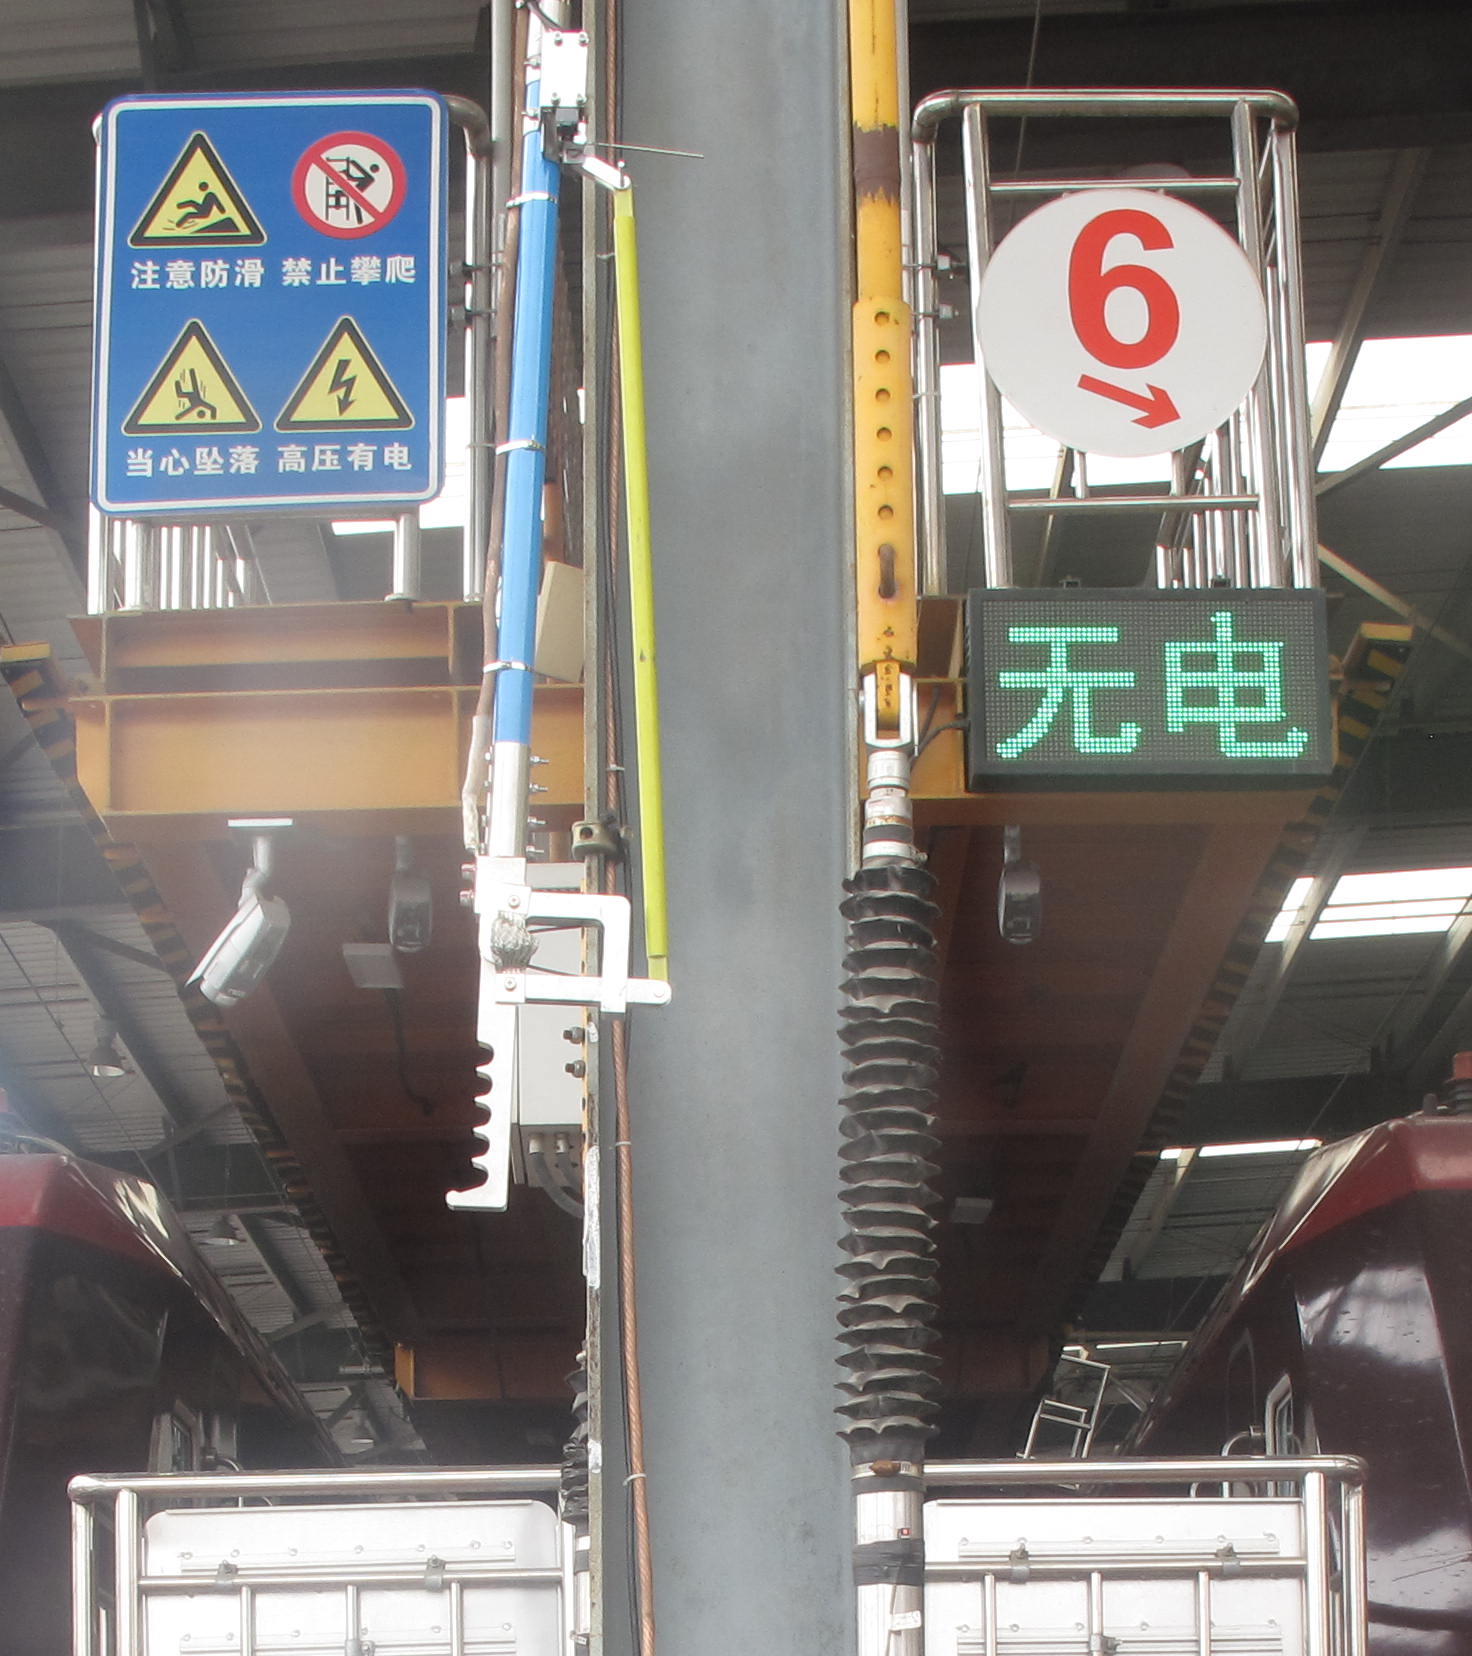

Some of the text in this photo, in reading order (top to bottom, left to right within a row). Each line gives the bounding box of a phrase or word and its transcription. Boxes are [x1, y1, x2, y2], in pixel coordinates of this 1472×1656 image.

[130, 255, 416, 290] 注意防滑 禁止攀爬
[1068, 208, 1180, 369] 6
[126, 442, 412, 477] 当心坠落 高压有电
[995, 610, 1309, 758] 无电
